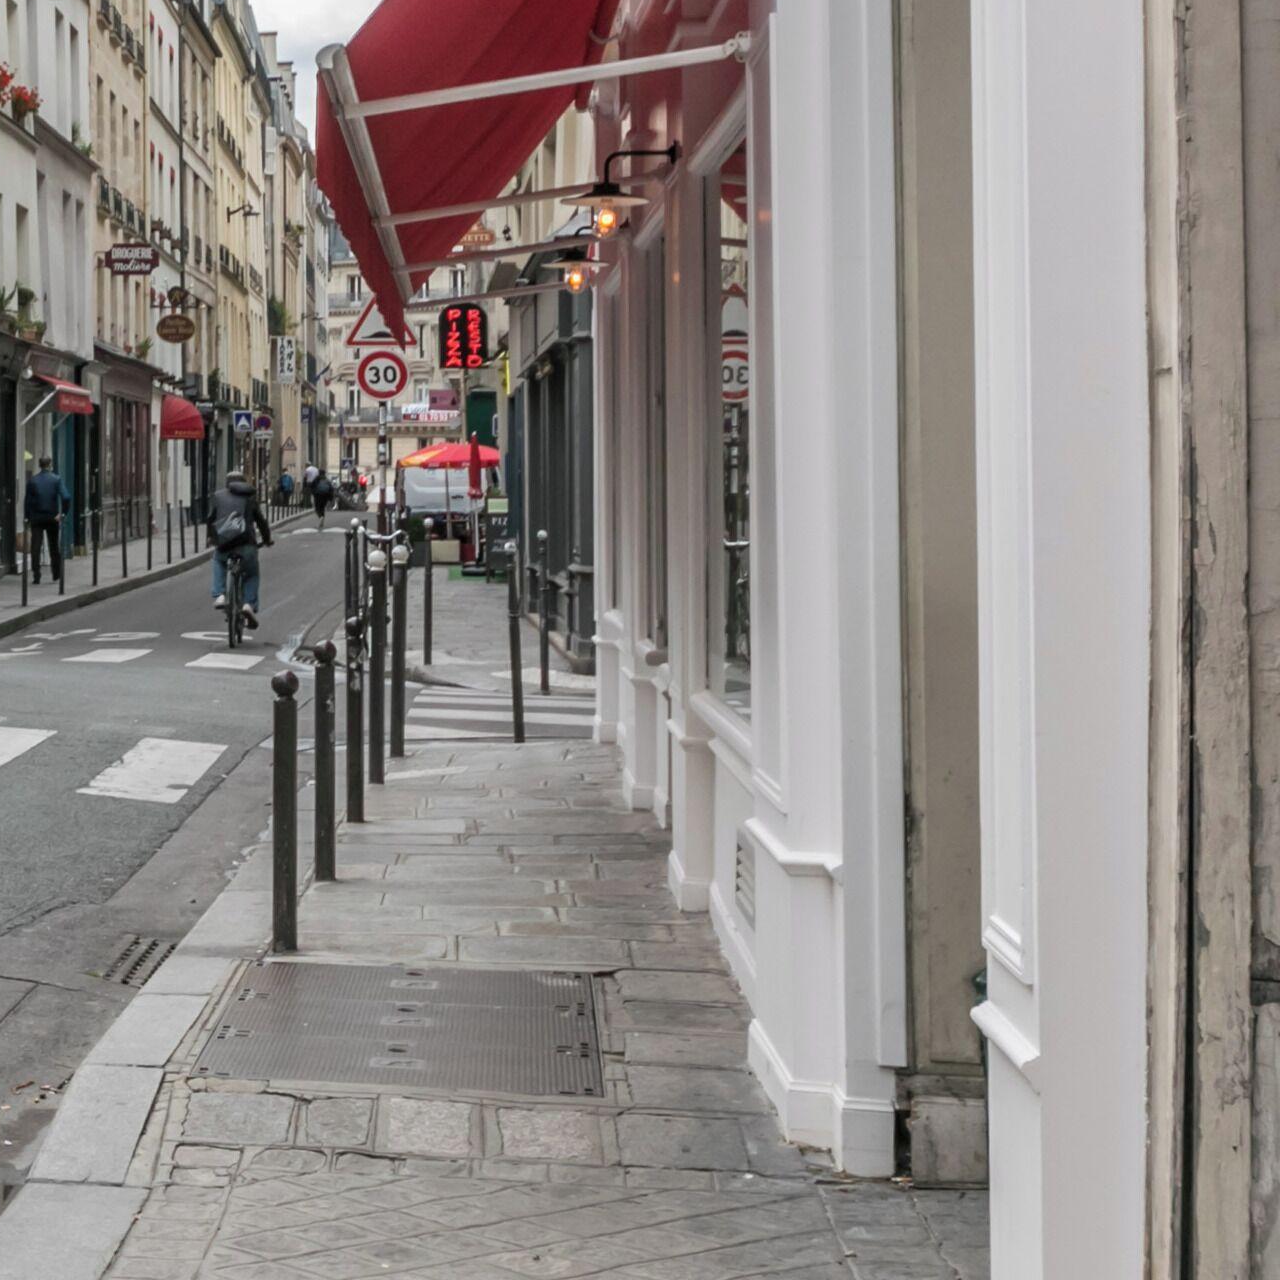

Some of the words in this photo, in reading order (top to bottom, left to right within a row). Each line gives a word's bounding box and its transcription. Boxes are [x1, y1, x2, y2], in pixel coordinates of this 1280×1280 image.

[111, 247, 153, 259] DROGUERIE
[446, 308, 463, 368] PIZZA
[467, 308, 483, 368] RESTO
[368, 366, 398, 385] 30
